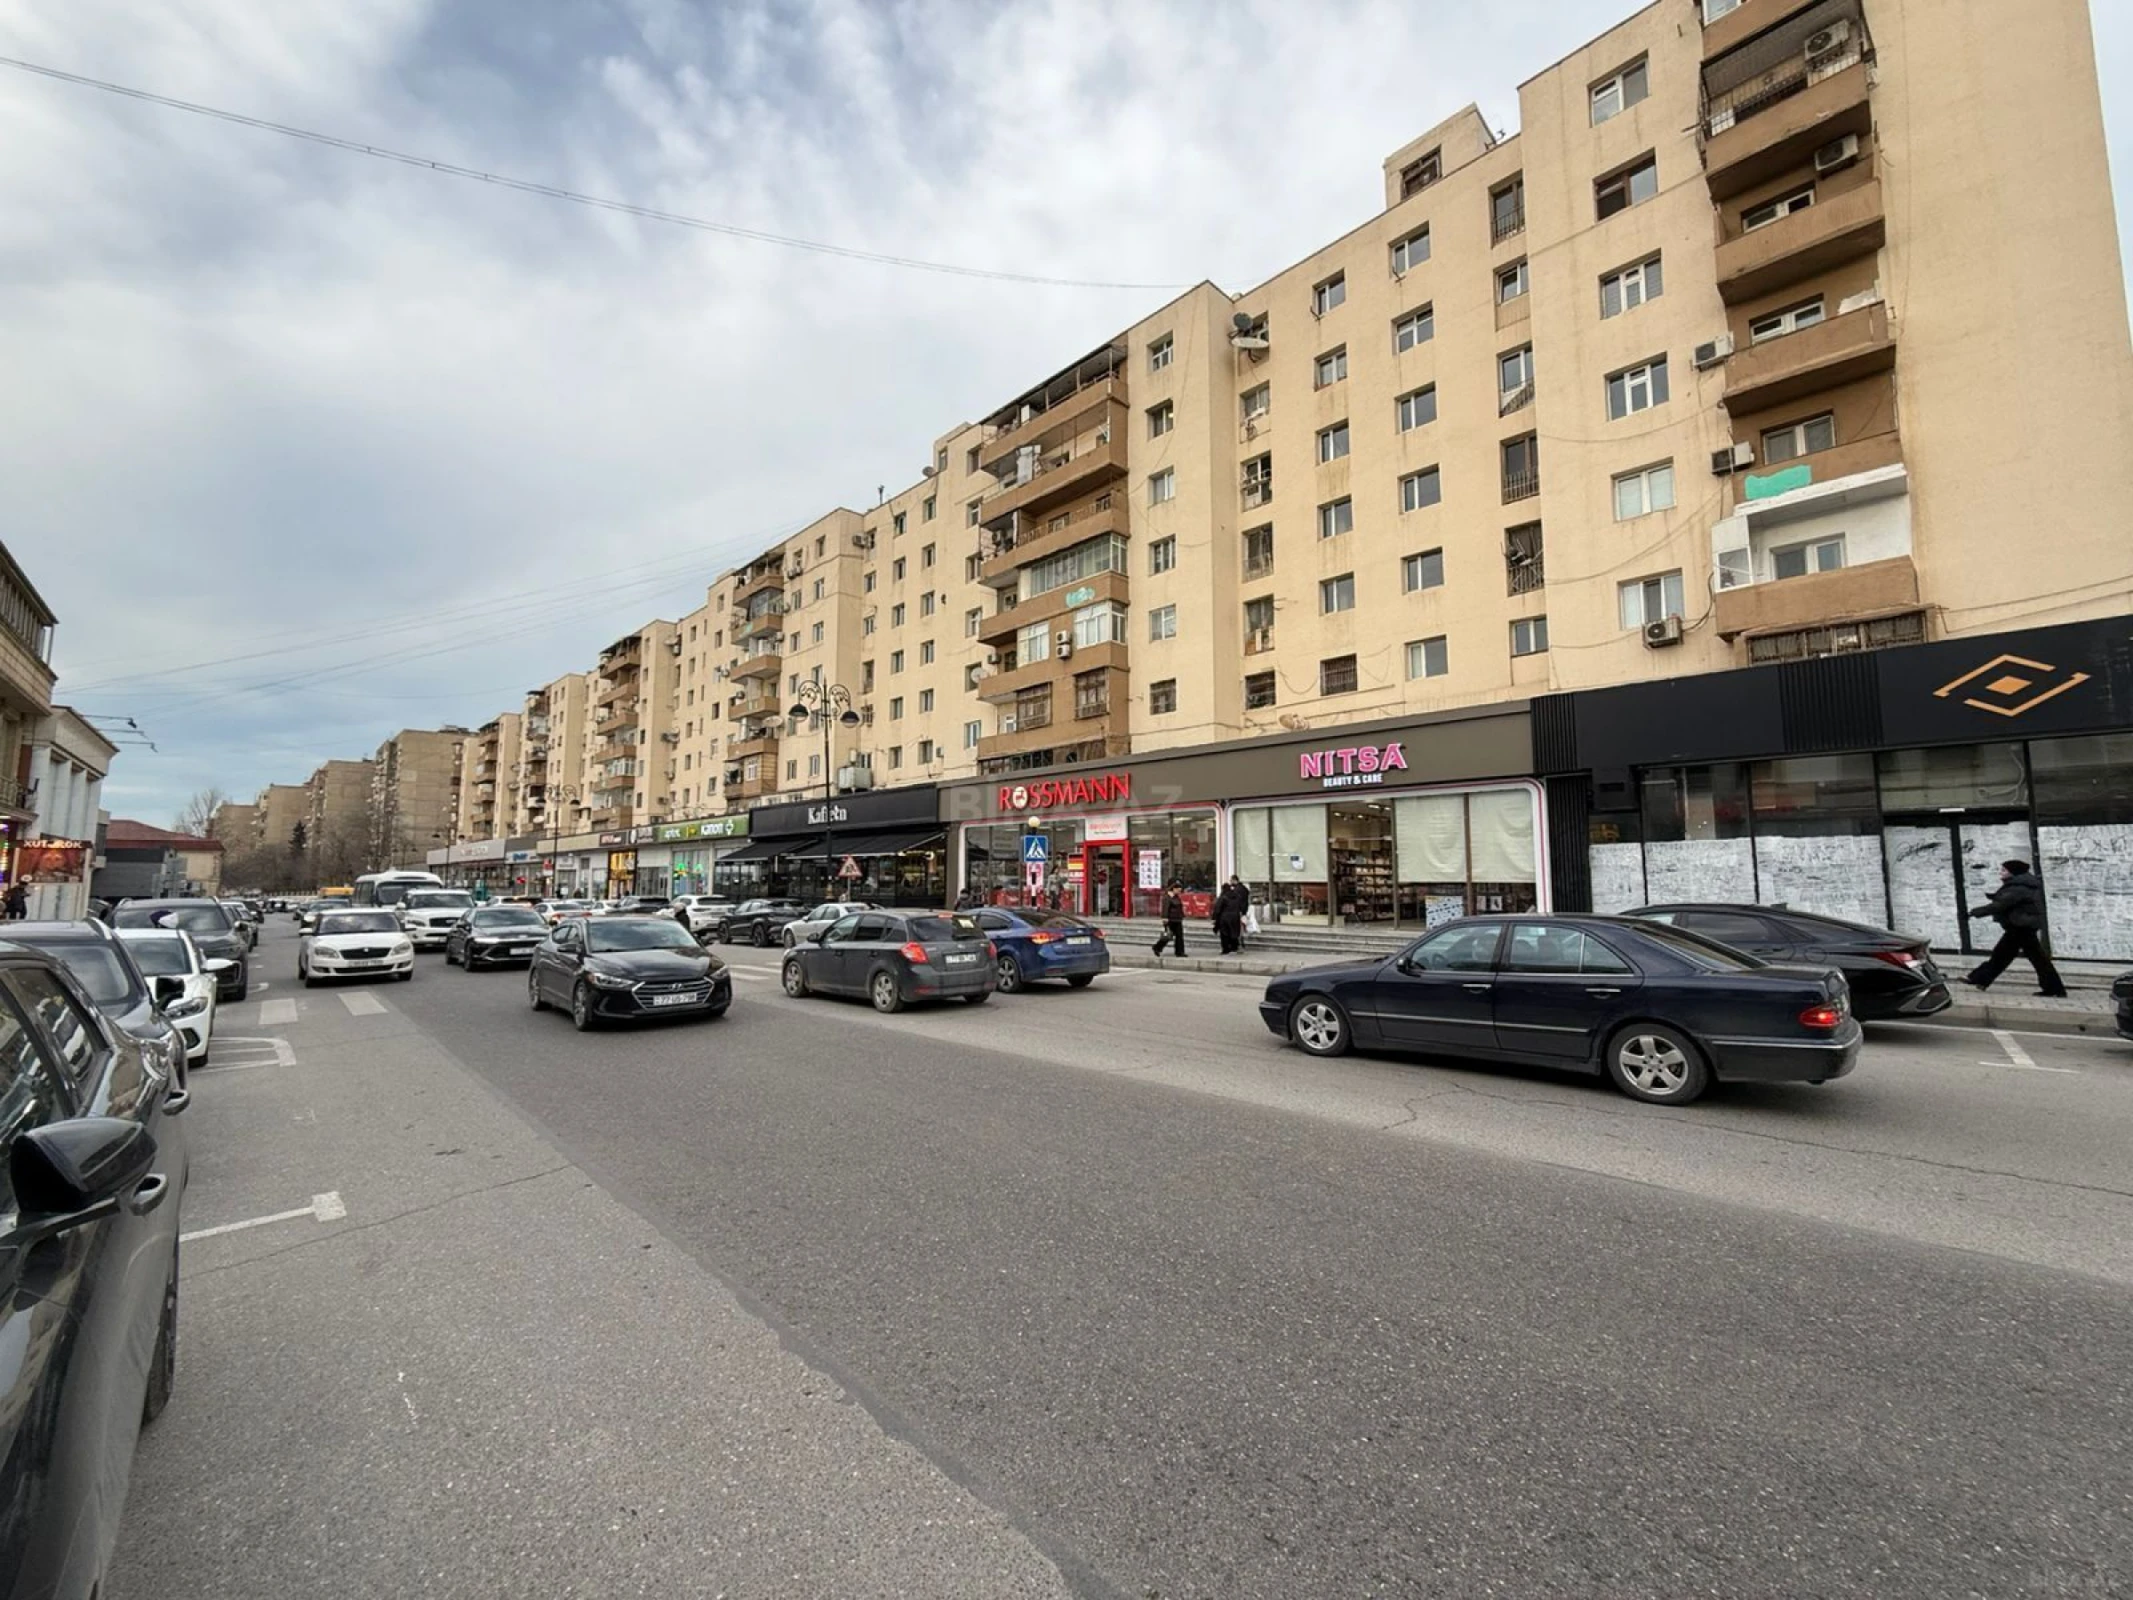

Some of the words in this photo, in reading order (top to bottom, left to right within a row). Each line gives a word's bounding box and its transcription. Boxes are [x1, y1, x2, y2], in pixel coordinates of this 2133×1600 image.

[1300, 743, 1408, 779] NITSA
[999, 773, 1131, 811] ROSSMANN
[1323, 775, 1352, 788] BEAUTY
[1353, 775, 1361, 785] &
[1362, 772, 1383, 784] CARE
